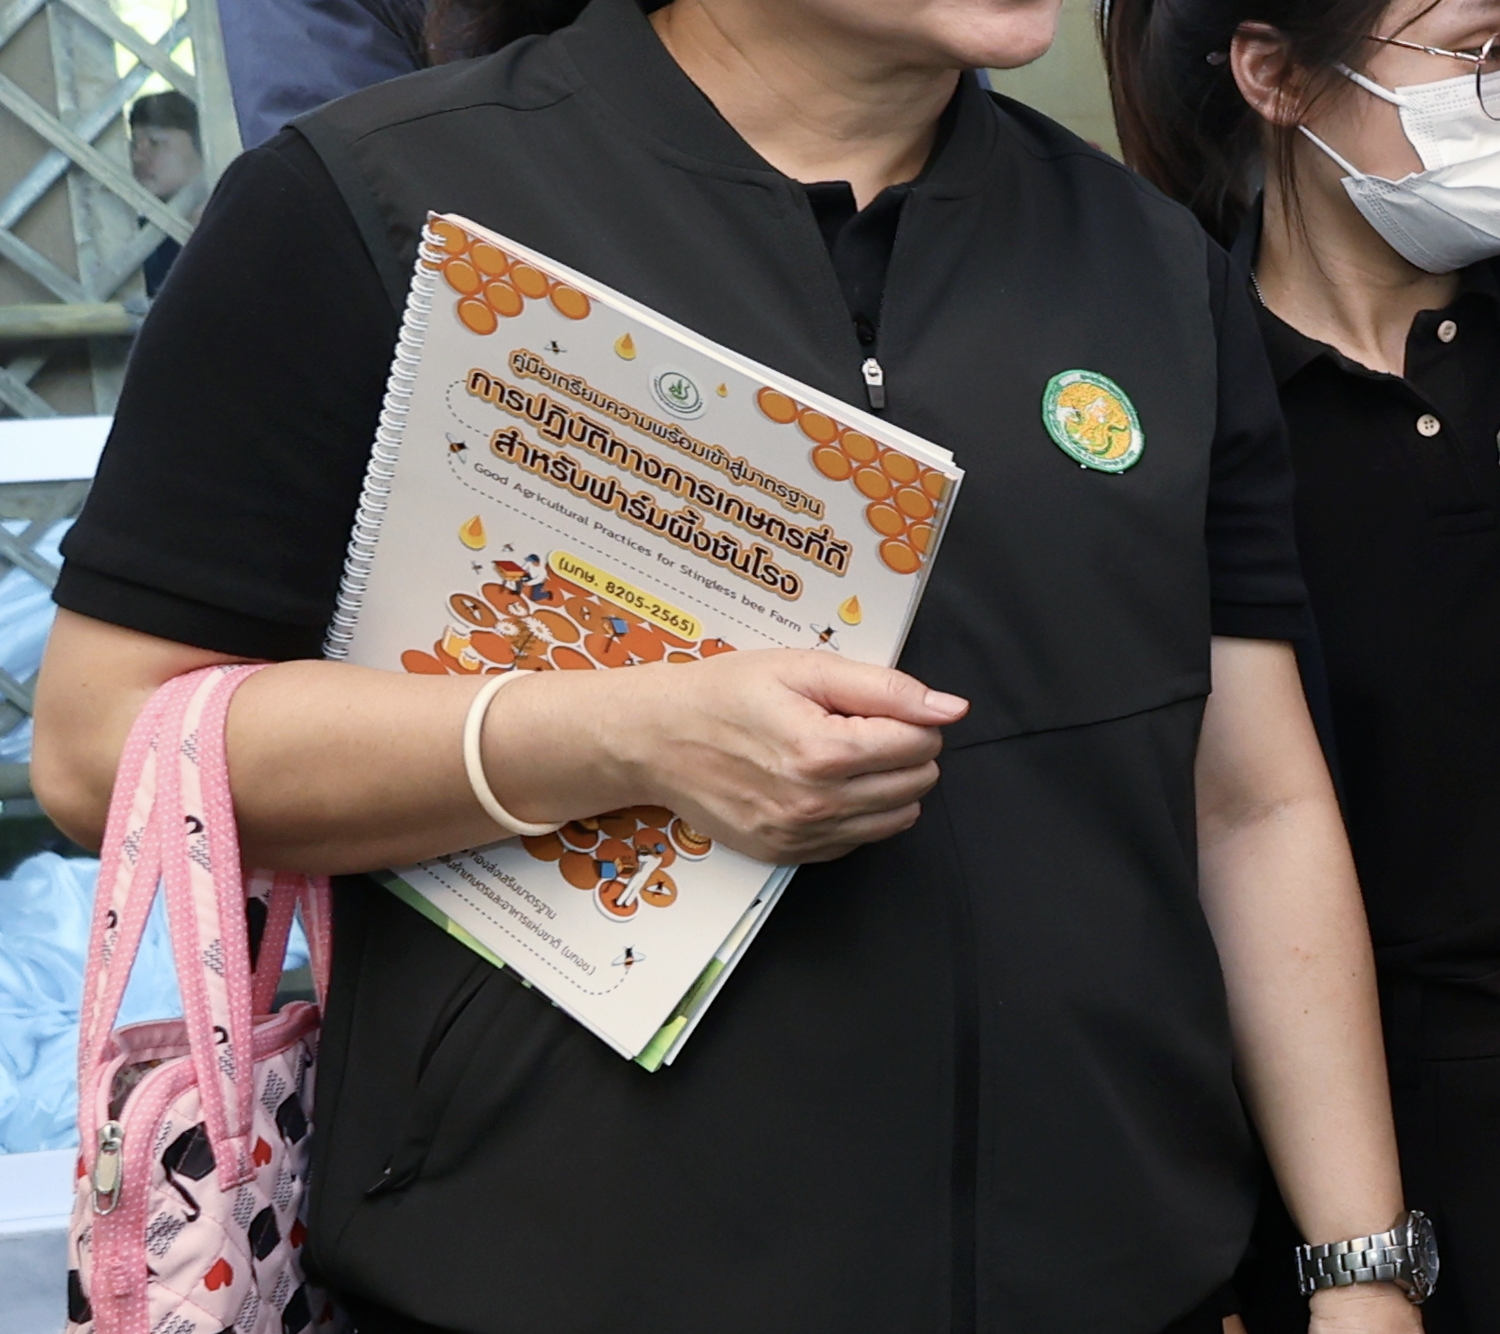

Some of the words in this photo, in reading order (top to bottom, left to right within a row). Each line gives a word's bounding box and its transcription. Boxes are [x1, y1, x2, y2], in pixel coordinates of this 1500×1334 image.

[466, 367, 855, 572] การปฏิบัติทางการเกษตรที่ดี
[471, 461, 510, 487] Good
[510, 480, 592, 527] Agricultural
[591, 519, 654, 558] Practices
[654, 551, 677, 569] for
[677, 562, 739, 602] Stingless
[739, 593, 768, 615] bee
[767, 608, 803, 633] Farm
[491, 424, 805, 598] สำหรับฟาร์มผึ้งชันโรง
[602, 580, 697, 637] 8205-2565)
